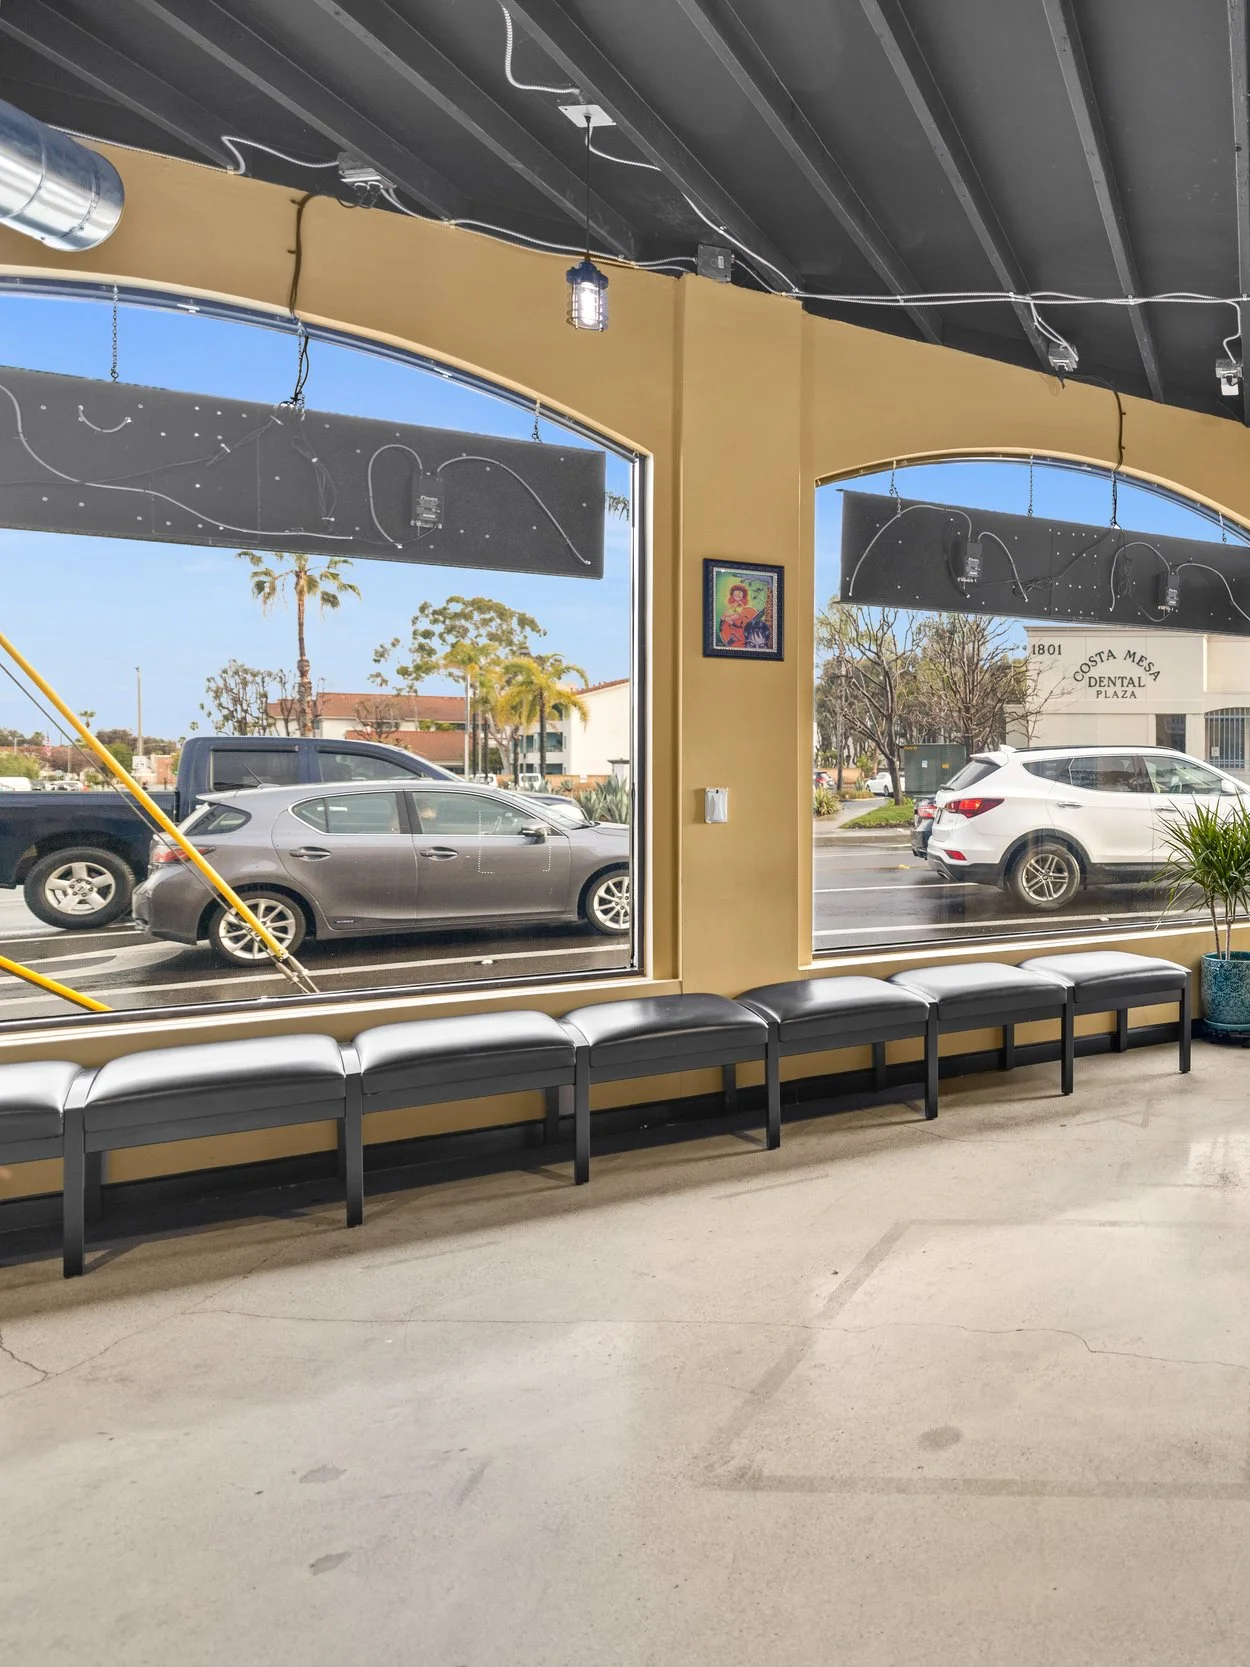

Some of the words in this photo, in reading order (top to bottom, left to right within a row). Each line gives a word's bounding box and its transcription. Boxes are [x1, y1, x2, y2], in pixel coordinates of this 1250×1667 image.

[1032, 644, 1062, 655] 1801
[1073, 649, 1117, 682] COSTA
[1123, 649, 1161, 682] MESA
[1088, 676, 1146, 688] DENTAL
[1096, 690, 1137, 699] PLAZA
